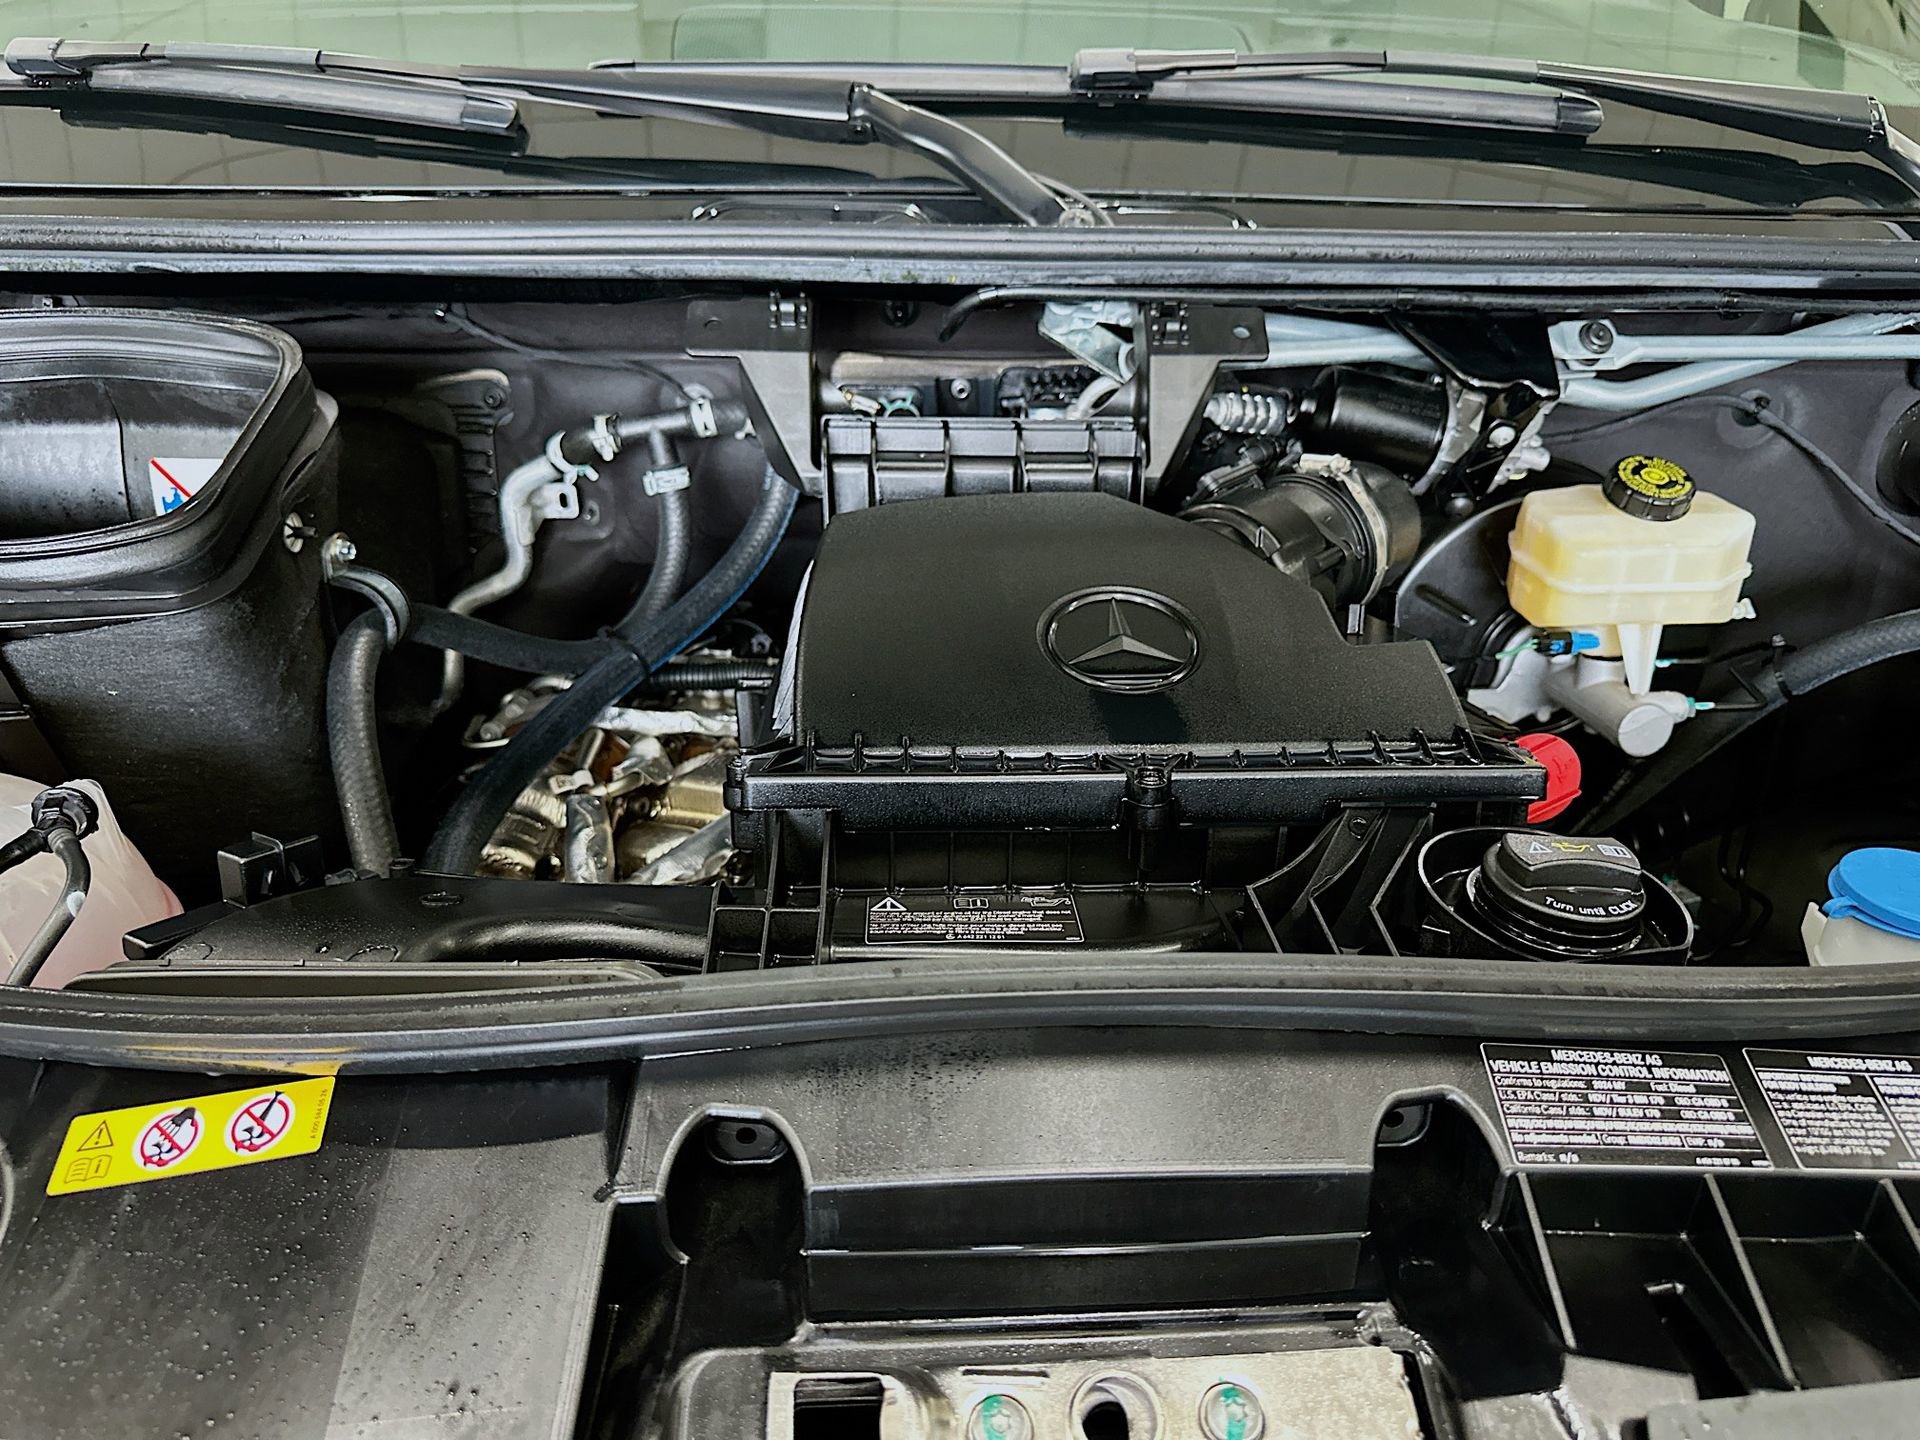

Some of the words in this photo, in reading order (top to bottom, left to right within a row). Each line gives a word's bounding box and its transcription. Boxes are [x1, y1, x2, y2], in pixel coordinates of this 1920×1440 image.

[1545, 896, 1574, 912] Turn
[1579, 907, 1606, 916] until
[1608, 900, 1638, 915] CLICK
[1551, 1049, 1645, 1065] MERCEDES-BENZ
[1646, 1053, 1663, 1066] AG
[1807, 1056, 1896, 1071] MERCEDES-BENZ
[1489, 1060, 1541, 1074] VEHICLE
[1540, 1061, 1598, 1076] EMISSION
[1598, 1064, 1653, 1079] CONTROL
[1652, 1067, 1729, 1082] INFORMATION
[1500, 1090, 1517, 1100] U.S.
[1517, 1091, 1534, 1100] EPA
